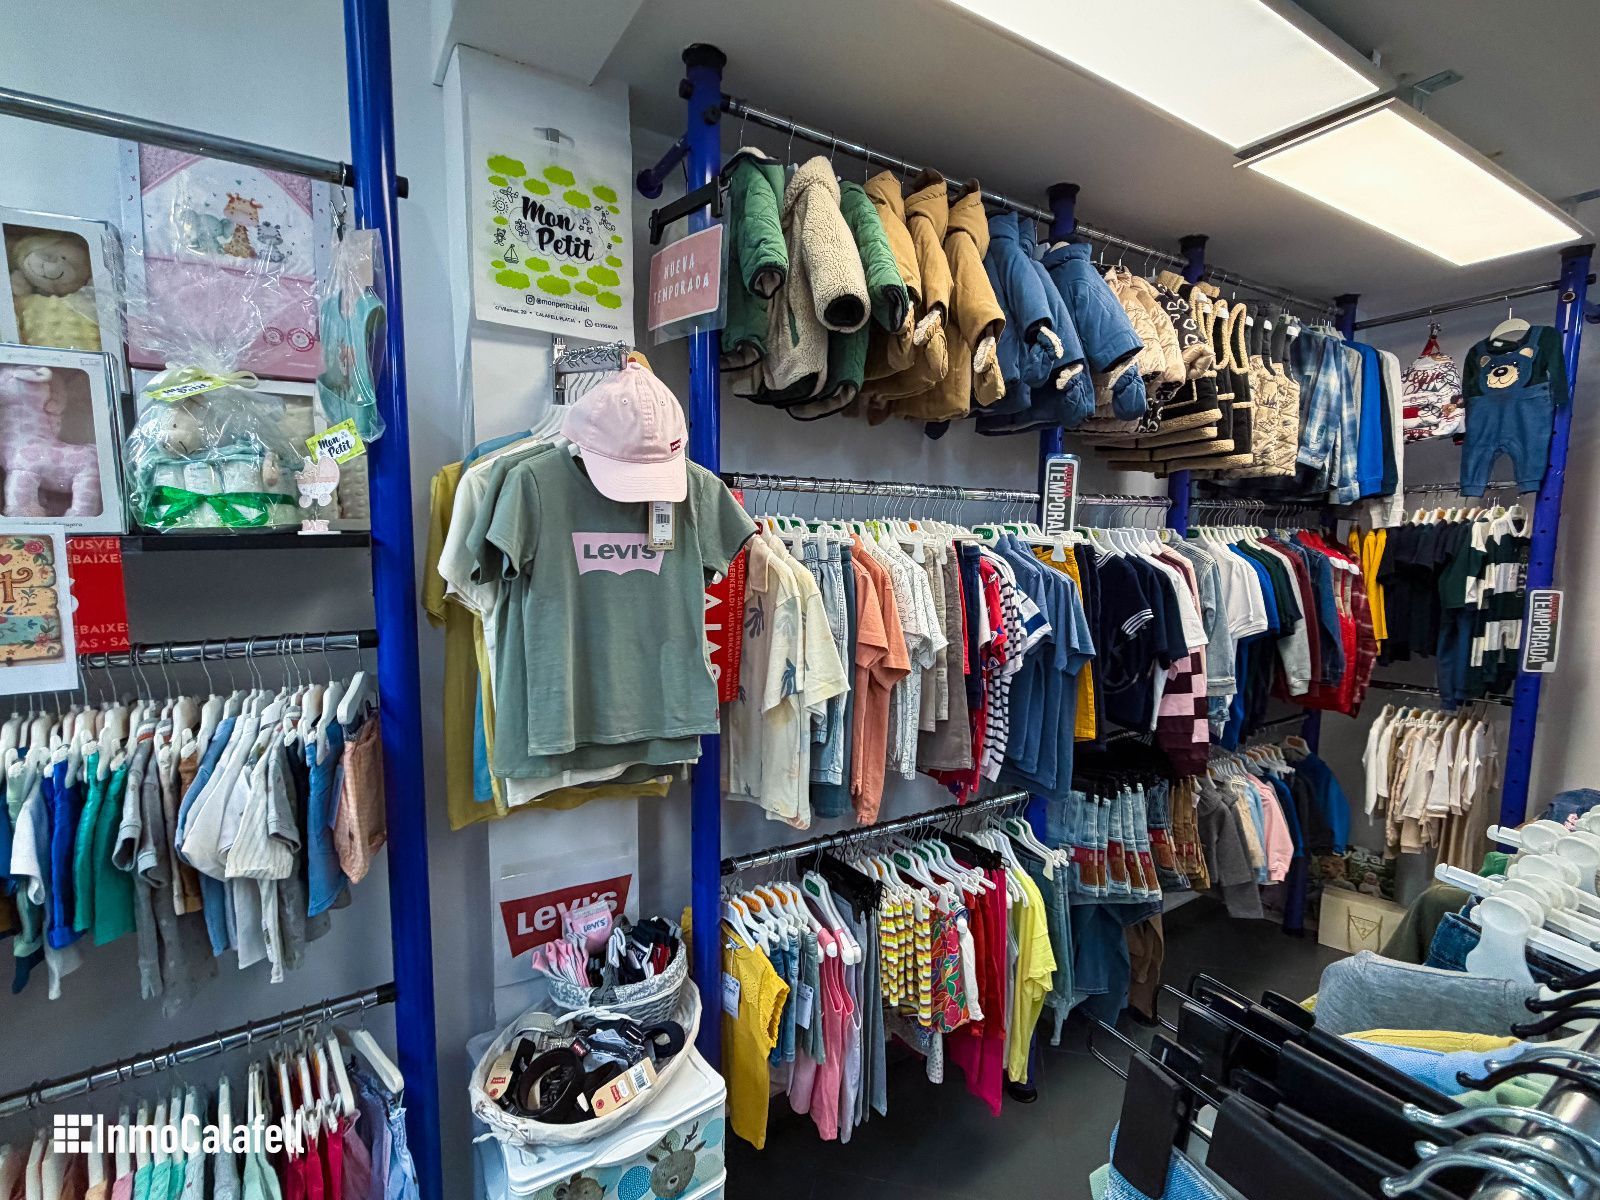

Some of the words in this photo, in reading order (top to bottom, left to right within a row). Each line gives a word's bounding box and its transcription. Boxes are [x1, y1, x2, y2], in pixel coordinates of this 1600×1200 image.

[521, 196, 575, 232] Mon
[536, 227, 594, 262] Petit
[663, 252, 695, 280] NUEVA
[653, 272, 709, 306] TEMPORADA
[317, 436, 341, 450] Mon
[327, 440, 354, 458] Petit
[1528, 595, 1554, 664] TEMPORADA
